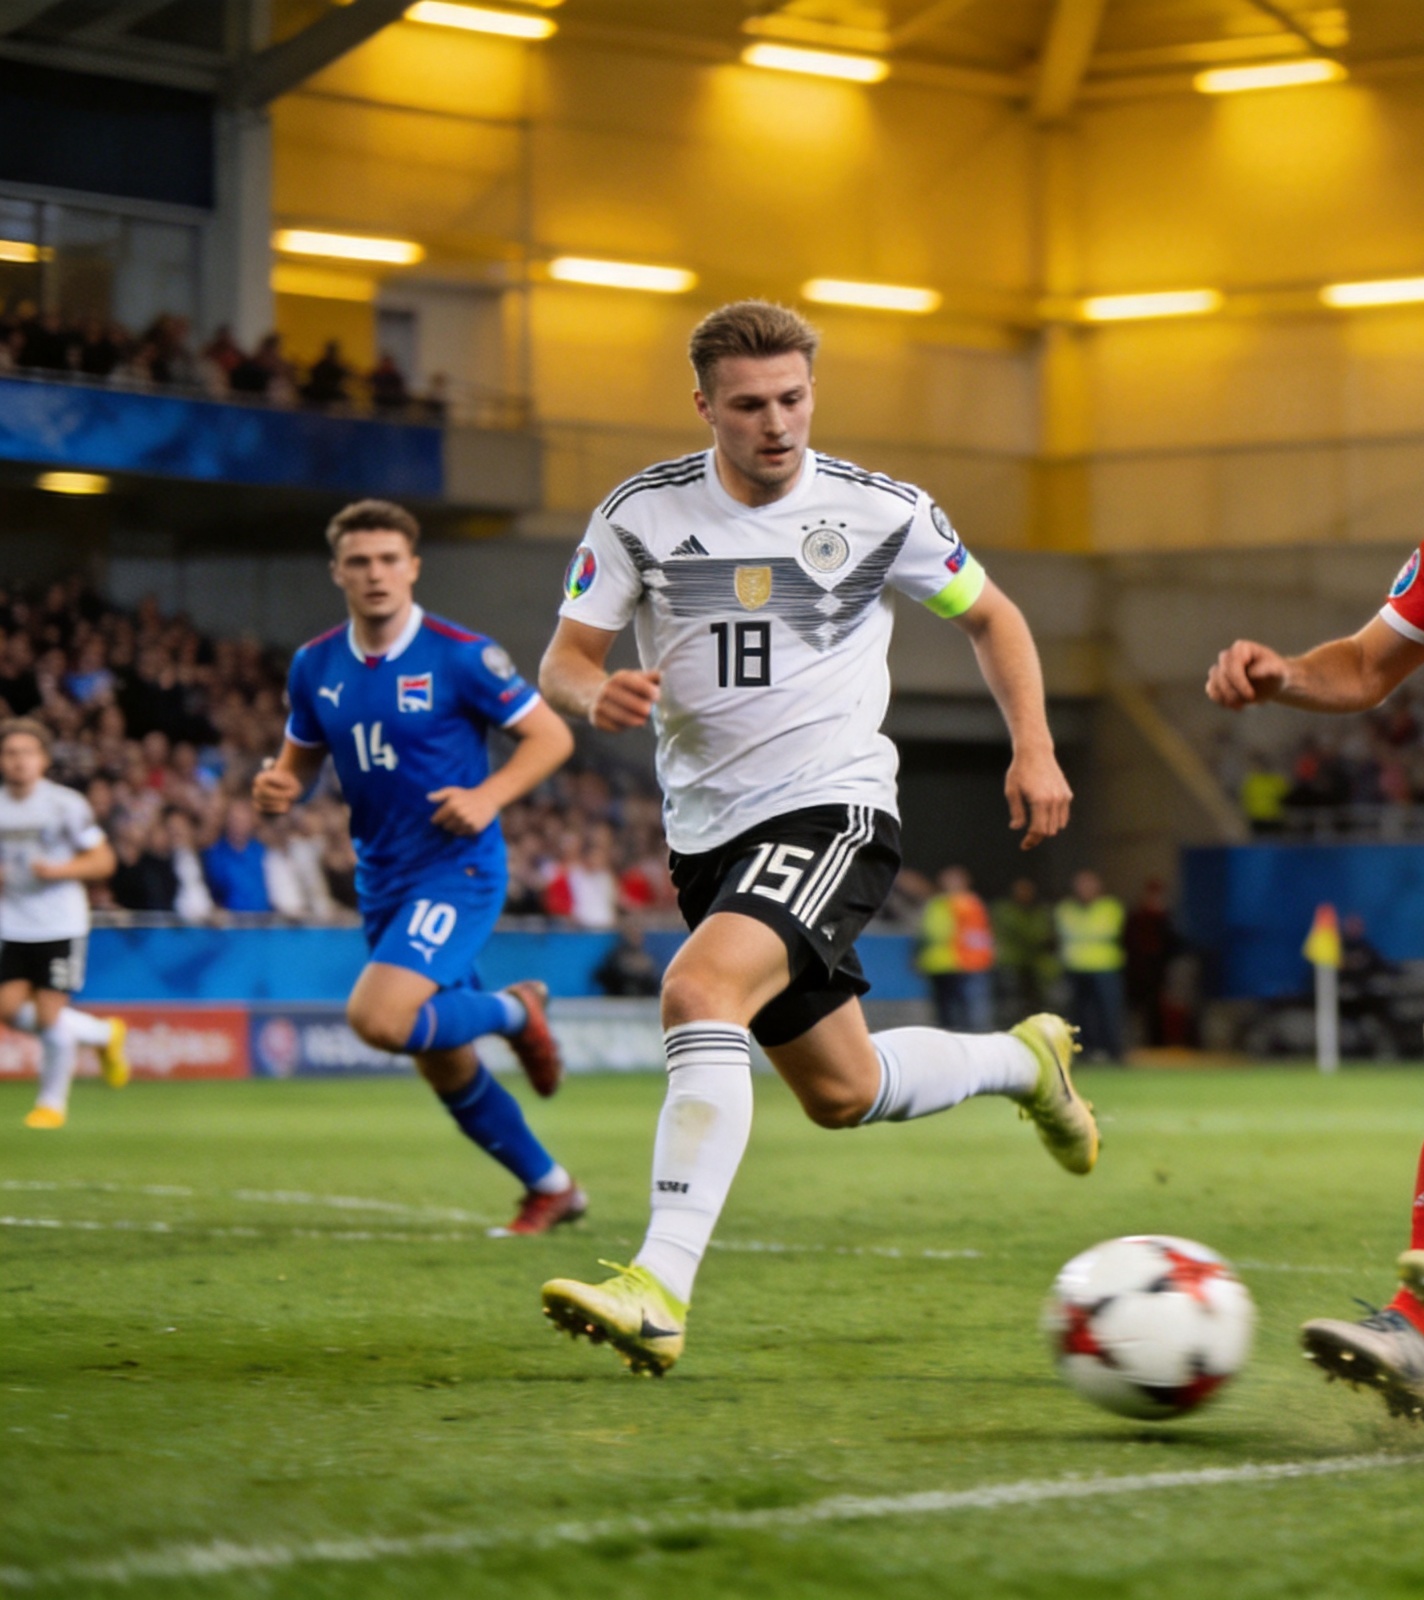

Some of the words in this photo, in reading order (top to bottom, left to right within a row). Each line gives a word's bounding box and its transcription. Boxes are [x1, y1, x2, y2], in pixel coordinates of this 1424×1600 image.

[710, 622, 771, 688] 18
[736, 842, 815, 904] 15
[407, 899, 457, 946] 10
